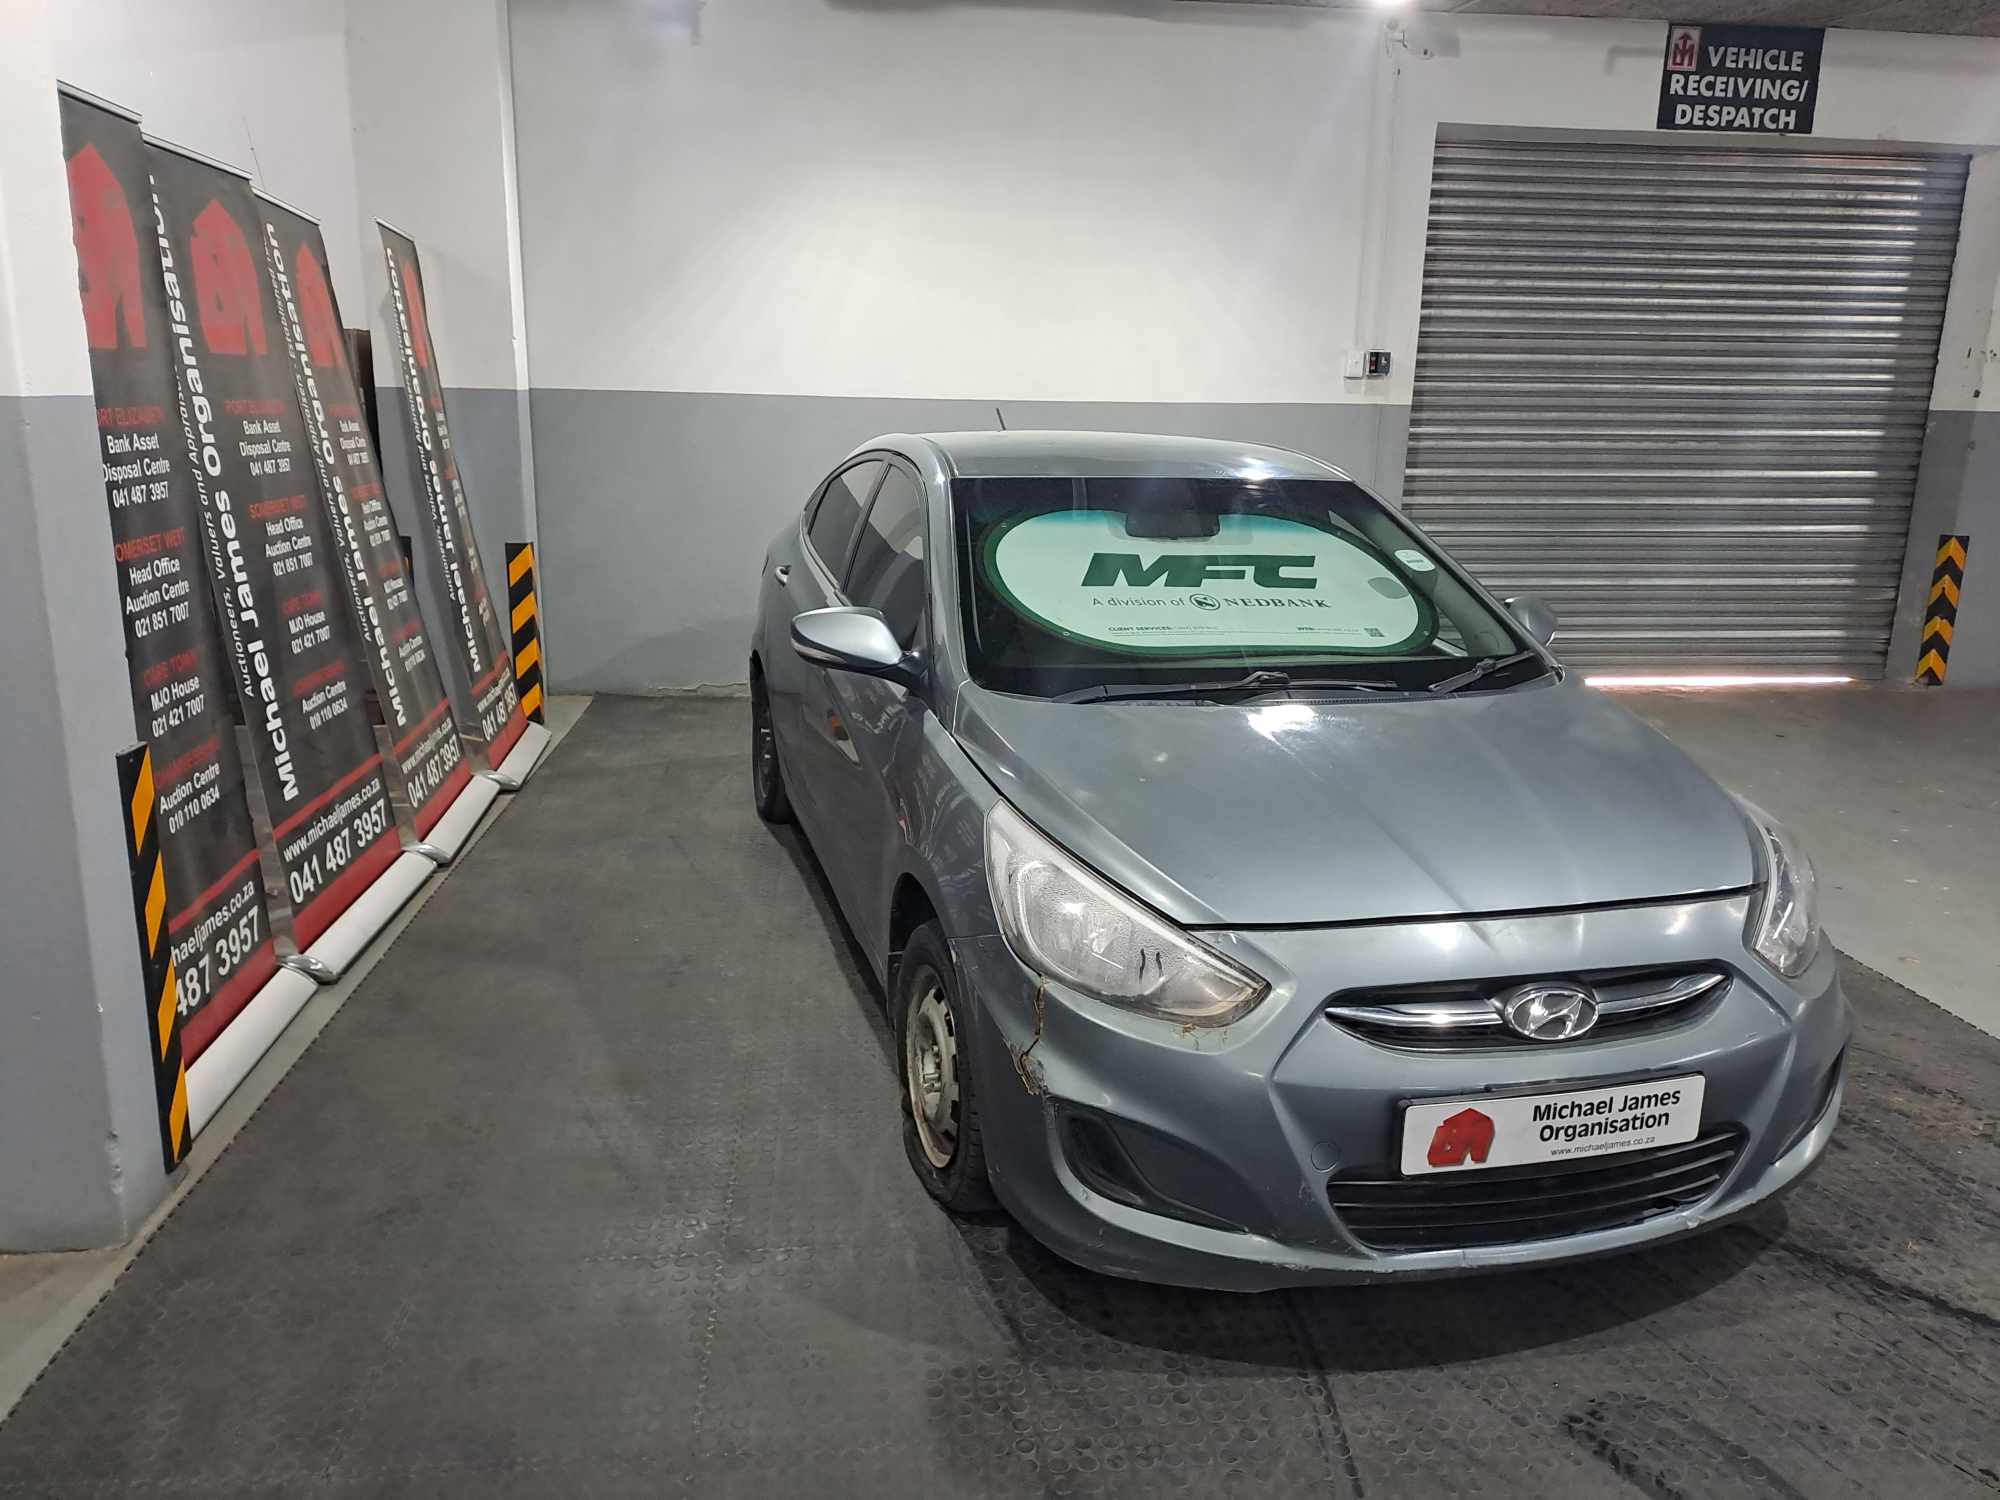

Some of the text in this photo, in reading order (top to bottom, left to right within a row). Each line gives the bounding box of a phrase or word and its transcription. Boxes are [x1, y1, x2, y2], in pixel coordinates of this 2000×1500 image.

[1708, 46, 1804, 72] VEHICLE
[1670, 74, 1808, 102] RECEIVING/
[1675, 104, 1797, 129] DESPATCH
[266, 223, 335, 465] Organisation
[106, 432, 160, 454] Bank Asset
[243, 420, 262, 435] Bank
[102, 457, 171, 485] Disposal Centre
[250, 461, 263, 476] 041
[315, 457, 330, 488] and
[112, 481, 169, 508] 041 487 3957
[192, 469, 208, 505] and
[266, 515, 304, 537] Head Office
[326, 491, 346, 547] Valuers
[333, 476, 369, 588] James
[204, 511, 226, 580] Valuers
[215, 489, 260, 629] James
[266, 540, 290, 558] Auction
[129, 557, 181, 586] Head Office
[273, 559, 286, 577] 021
[286, 556, 299, 573] 851
[1081, 553, 1317, 589] MFC
[126, 579, 190, 615] Auction Centre
[1107, 596, 1168, 608] division
[1170, 596, 1185, 607] of
[1223, 599, 1332, 609] NEDBANK
[135, 601, 190, 639] 021 851 7007
[288, 611, 326, 634] MJO House
[450, 561, 480, 672] Michael
[224, 587, 255, 697] Auctioneers,
[291, 637, 304, 655] 021
[303, 631, 315, 649] 421
[363, 597, 407, 727] Michael
[150, 676, 200, 712] MJO House
[302, 689, 326, 714] Auction
[152, 694, 205, 738] 021 421 7007
[248, 639, 299, 801] Michael
[160, 782, 193, 815] Auction
[193, 762, 221, 789] Centre
[408, 734, 460, 809] 041 487 3957
[168, 787, 220, 835] 010 110 0634
[284, 778, 380, 863] www.michaeljames.co.za
[290, 799, 387, 905] 041 487 3957
[175, 905, 260, 1017] 487 3957
[1532, 1089, 1681, 1122] Michael James
[1539, 1111, 1670, 1143] Organisation
[1551, 1136, 1655, 1156] www.michaeljames.co.za
